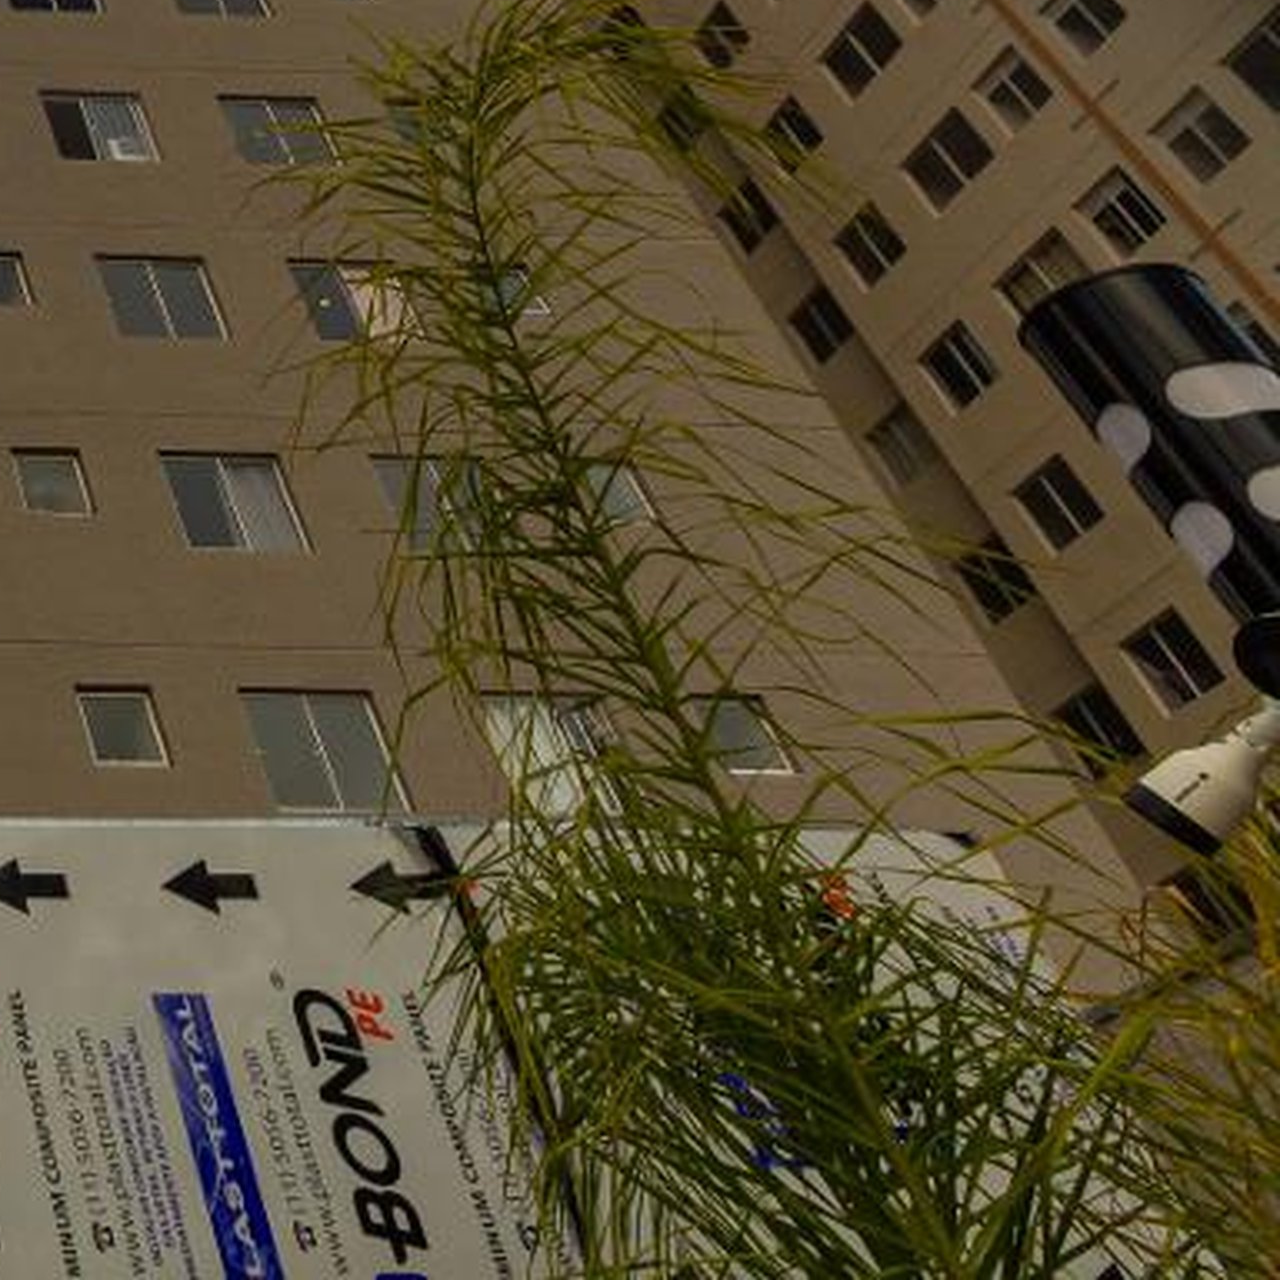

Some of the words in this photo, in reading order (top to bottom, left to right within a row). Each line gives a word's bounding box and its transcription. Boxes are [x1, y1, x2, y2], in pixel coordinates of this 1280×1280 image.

[7, 990, 37, 1053] PANEL
[345, 991, 396, 1040] PE
[22, 1059, 64, 1183] COMPOSITE
